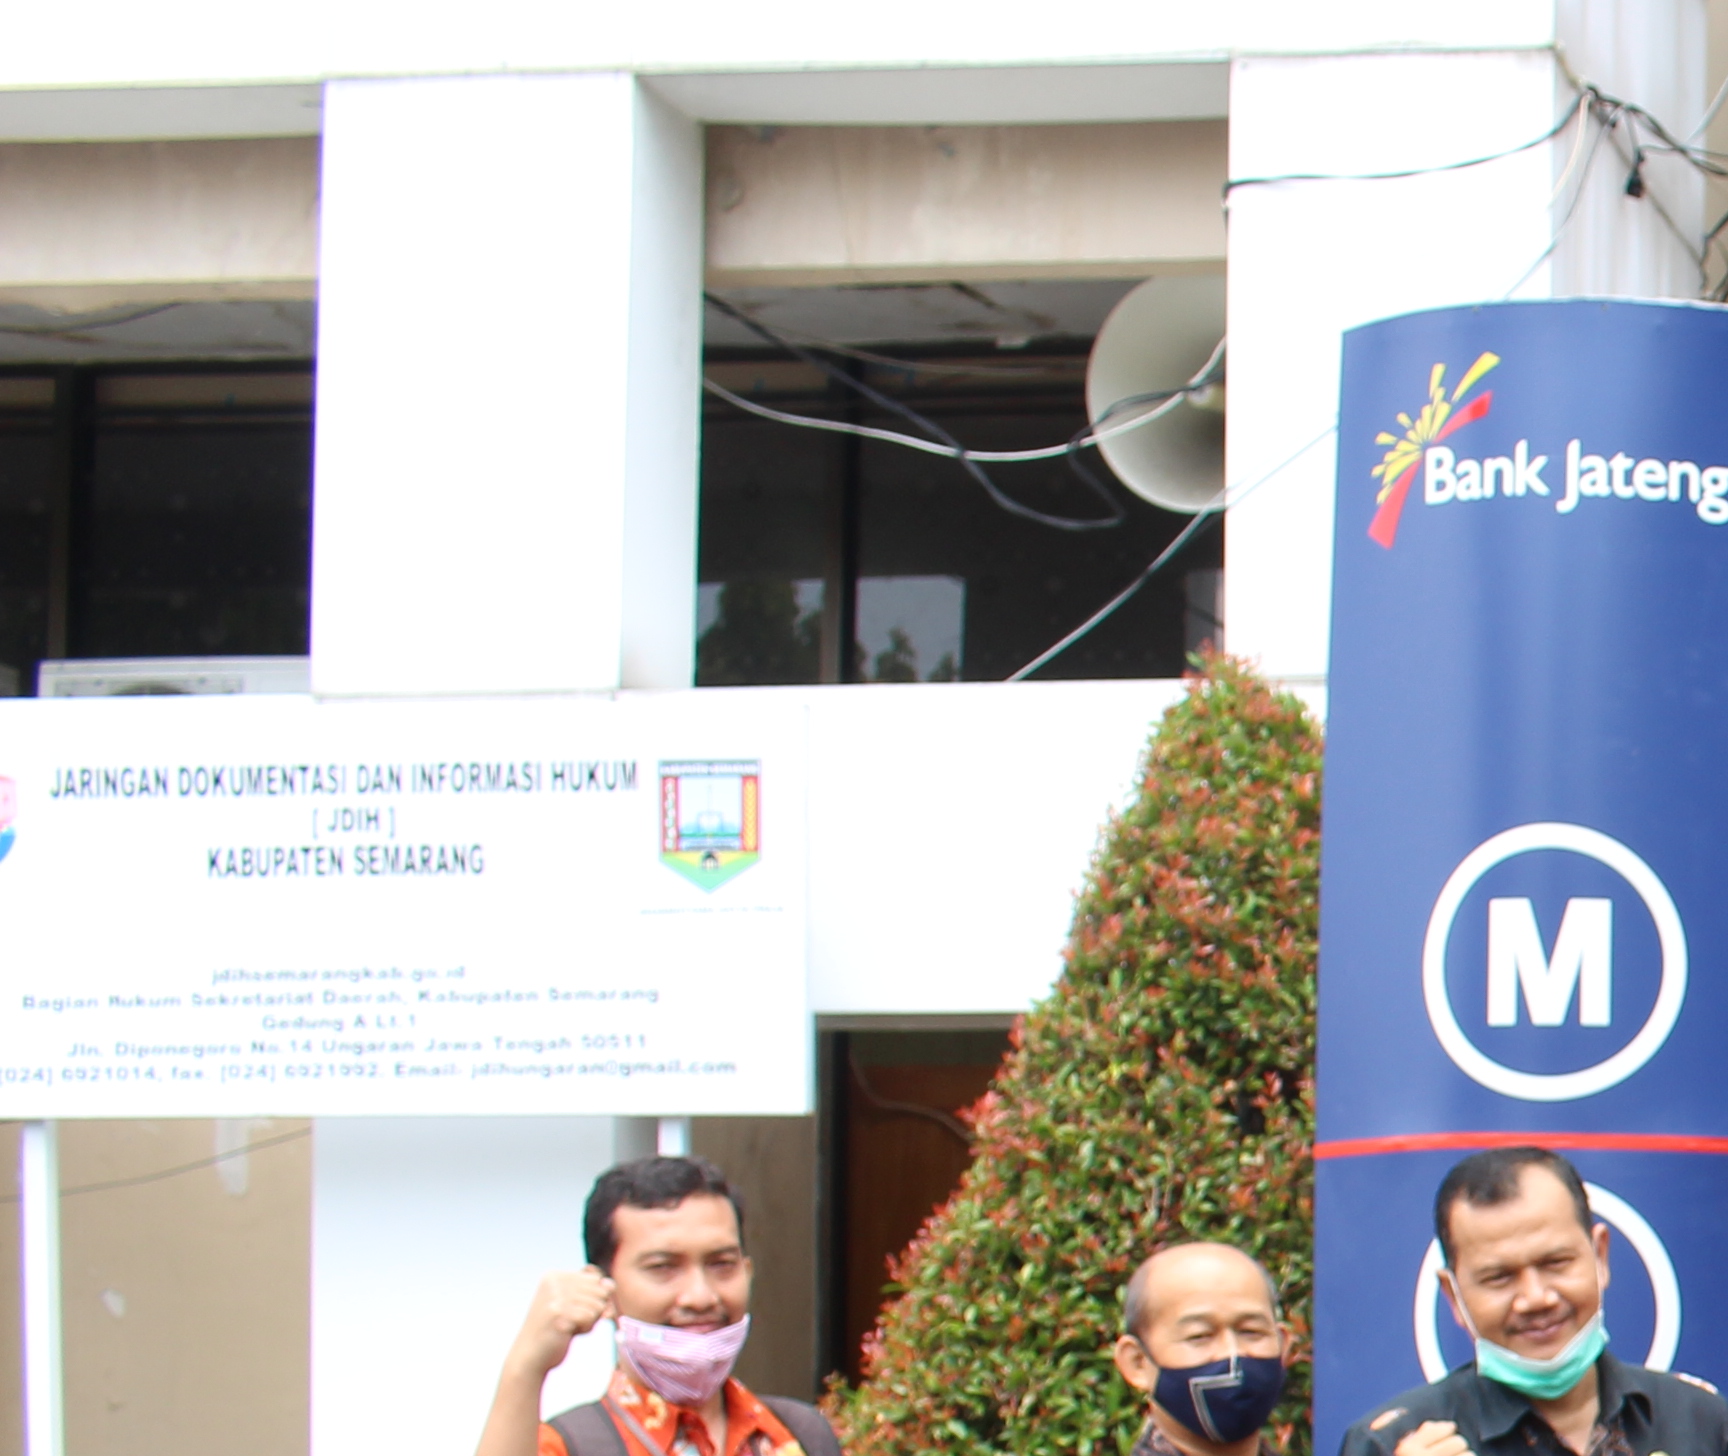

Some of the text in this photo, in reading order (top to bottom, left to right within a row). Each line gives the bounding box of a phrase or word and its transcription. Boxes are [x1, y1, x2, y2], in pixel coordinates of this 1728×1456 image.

[1424, 437, 1552, 507] Bank
[50, 767, 167, 799] JARINGAN
[178, 764, 344, 797] DOKUMENTASI
[357, 764, 400, 794] DAN
[412, 762, 540, 793] INFORMASI
[551, 761, 636, 792] HUKUM
[208, 844, 483, 877] KABUPATEN SEMARANG
[1486, 897, 1613, 1028] M
[21, 993, 98, 1013] Bagian
[548, 986, 658, 1004] Semarang
[353, 1013, 366, 1028] A
[321, 1039, 414, 1057] Ungaran
[425, 1038, 482, 1052] Jawa
[493, 1035, 570, 1054] Tengah
